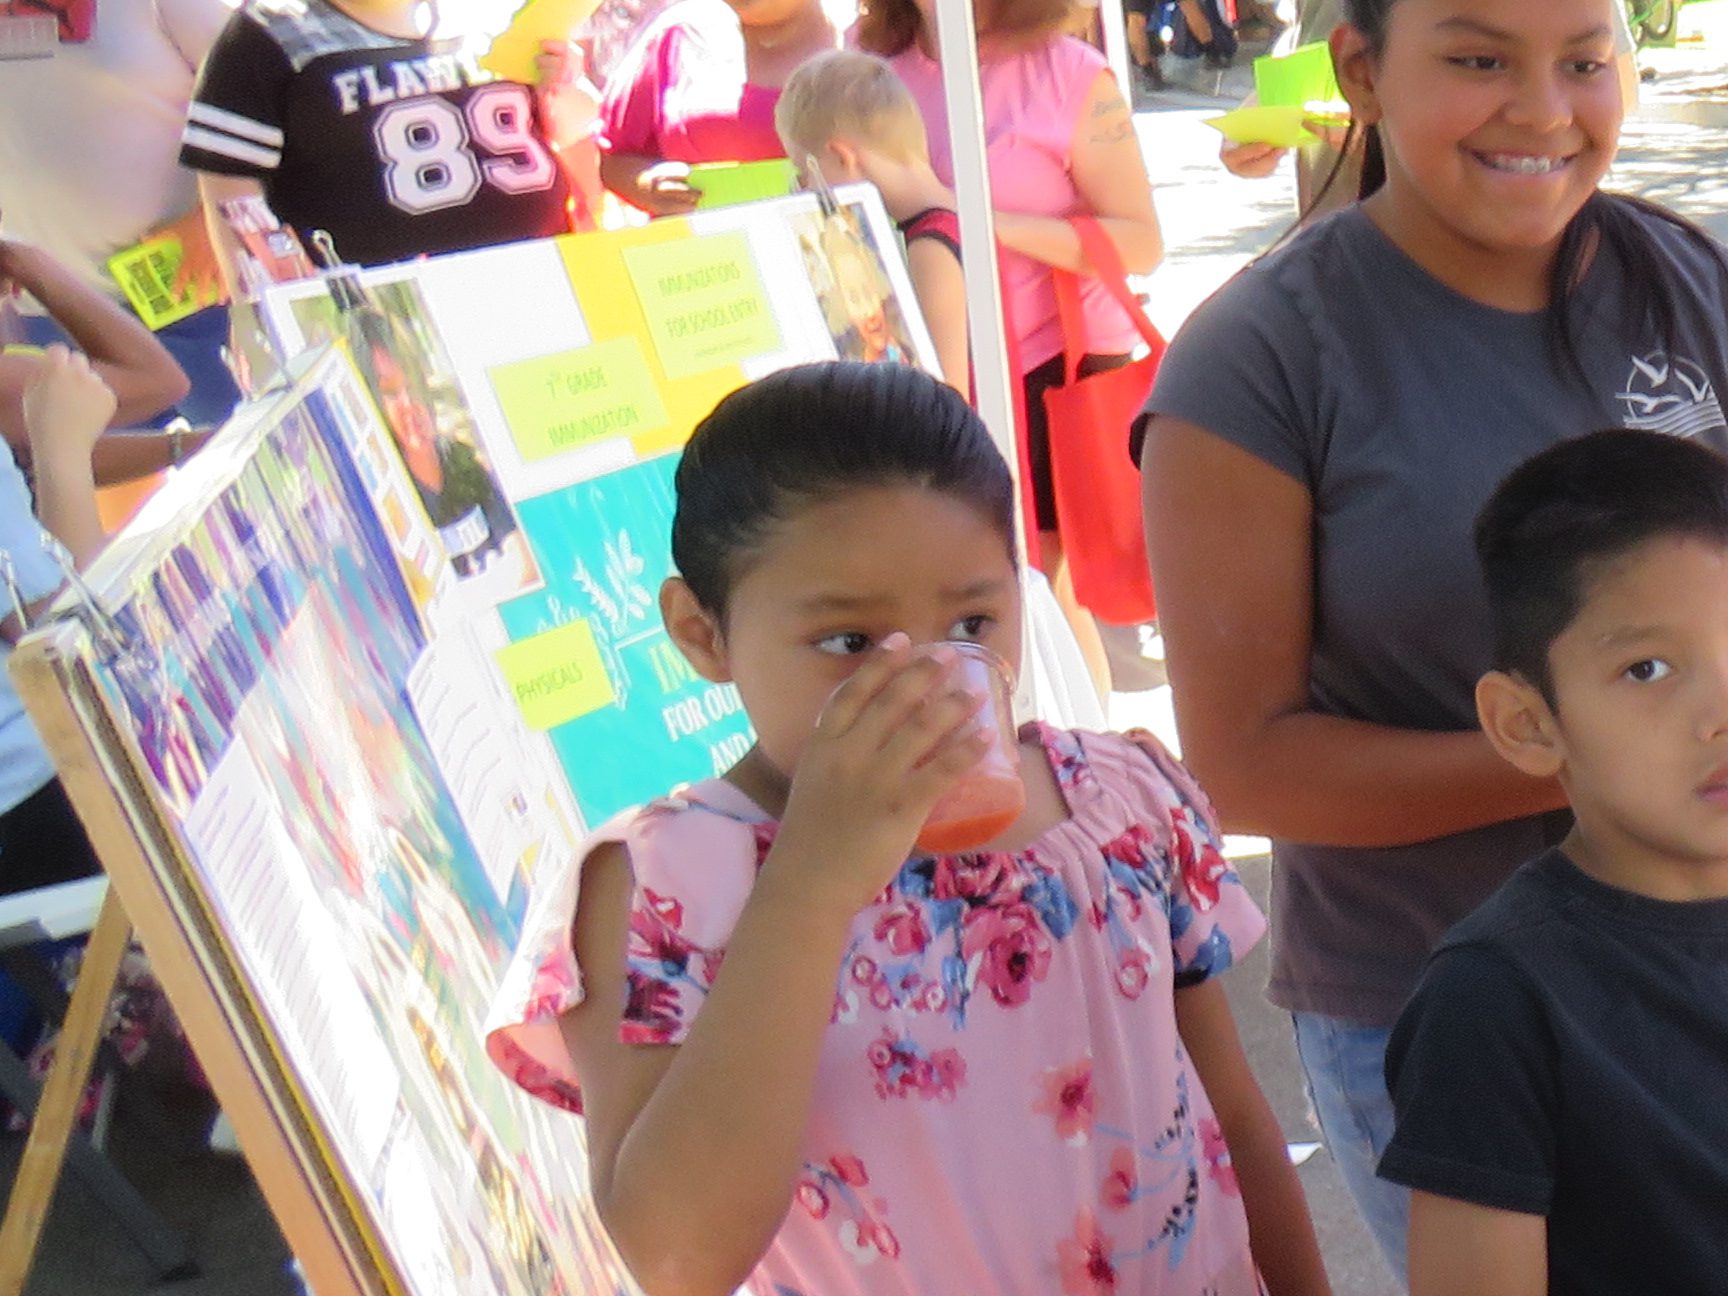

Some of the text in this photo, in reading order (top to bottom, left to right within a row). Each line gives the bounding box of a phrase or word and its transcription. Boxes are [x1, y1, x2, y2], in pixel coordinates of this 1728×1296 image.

[332, 53, 495, 116] FLAWL
[373, 81, 557, 216] 89
[657, 261, 742, 297] IMMUNIZATIONS
[664, 316, 690, 340] FOR
[688, 306, 728, 335] SCHOOL
[548, 405, 640, 447] IMMUNIZATION
[516, 661, 584, 704] PHYSICALS
[662, 696, 708, 742] FOR
[708, 731, 750, 779] AND
